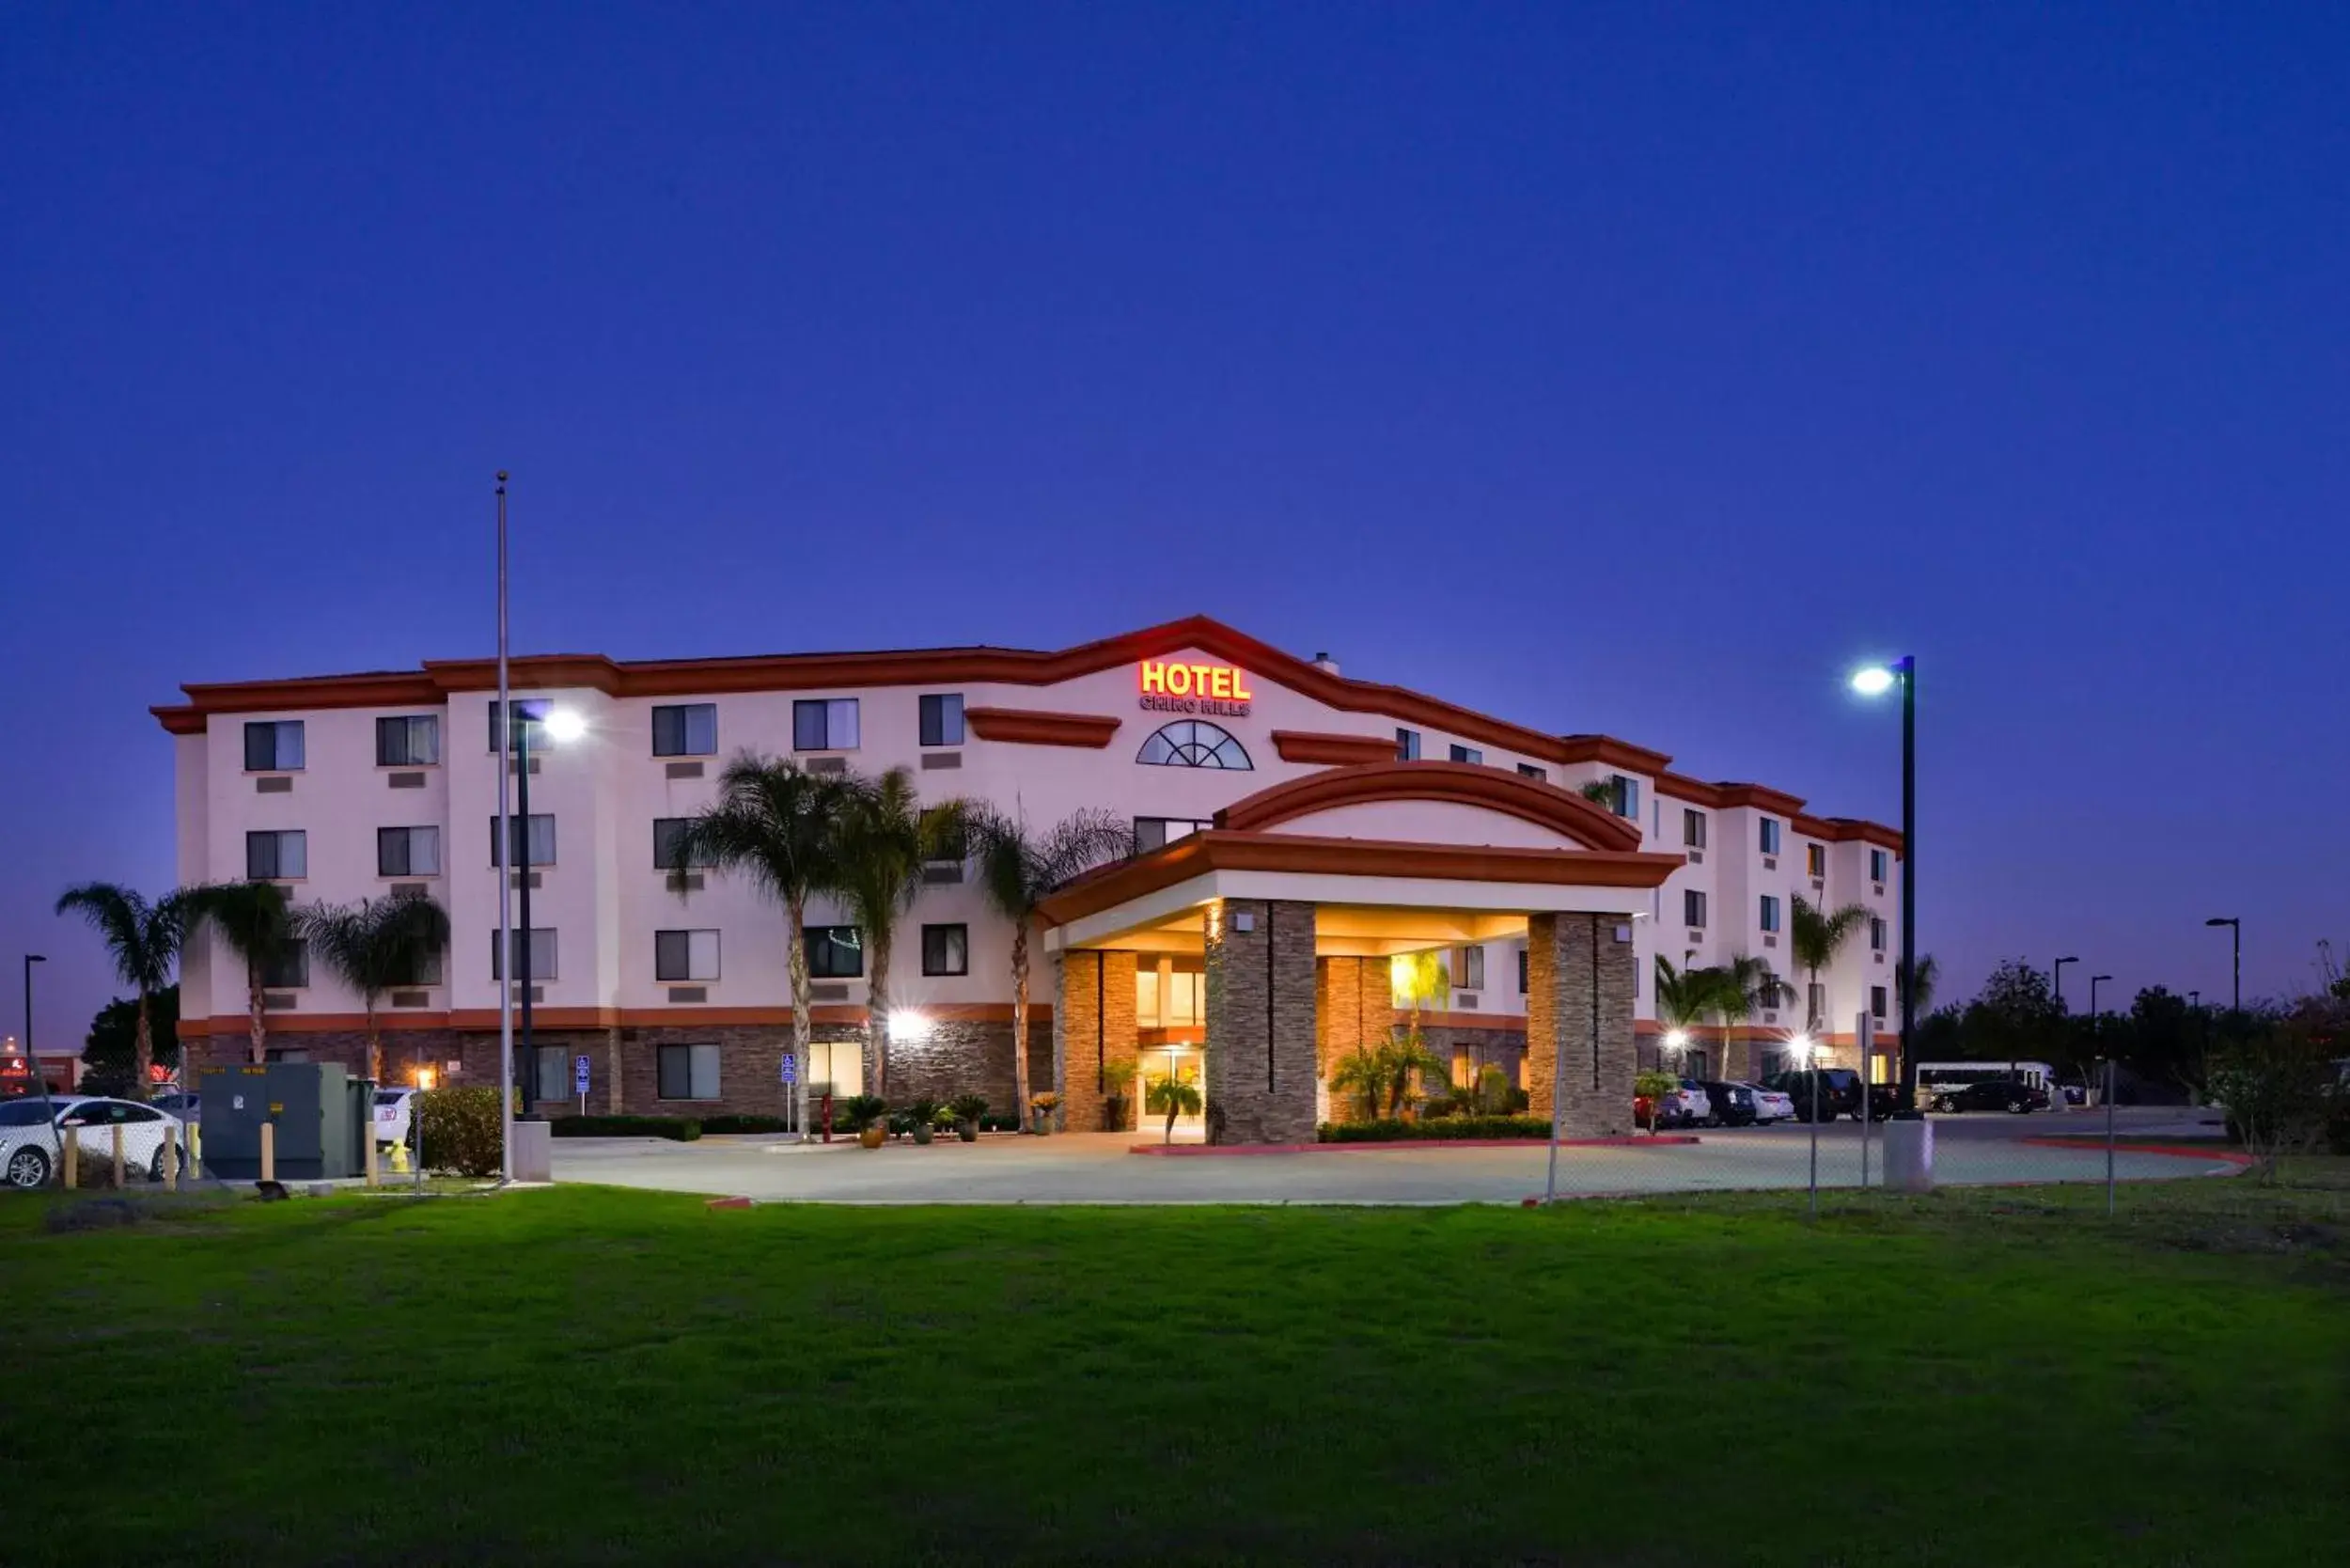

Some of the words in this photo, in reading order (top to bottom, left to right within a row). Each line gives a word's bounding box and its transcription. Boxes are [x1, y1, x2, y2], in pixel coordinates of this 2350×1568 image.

[1141, 661, 1251, 700] HOTEL
[1139, 696, 1196, 713] CHINO
[1200, 699, 1251, 716] HILLS
